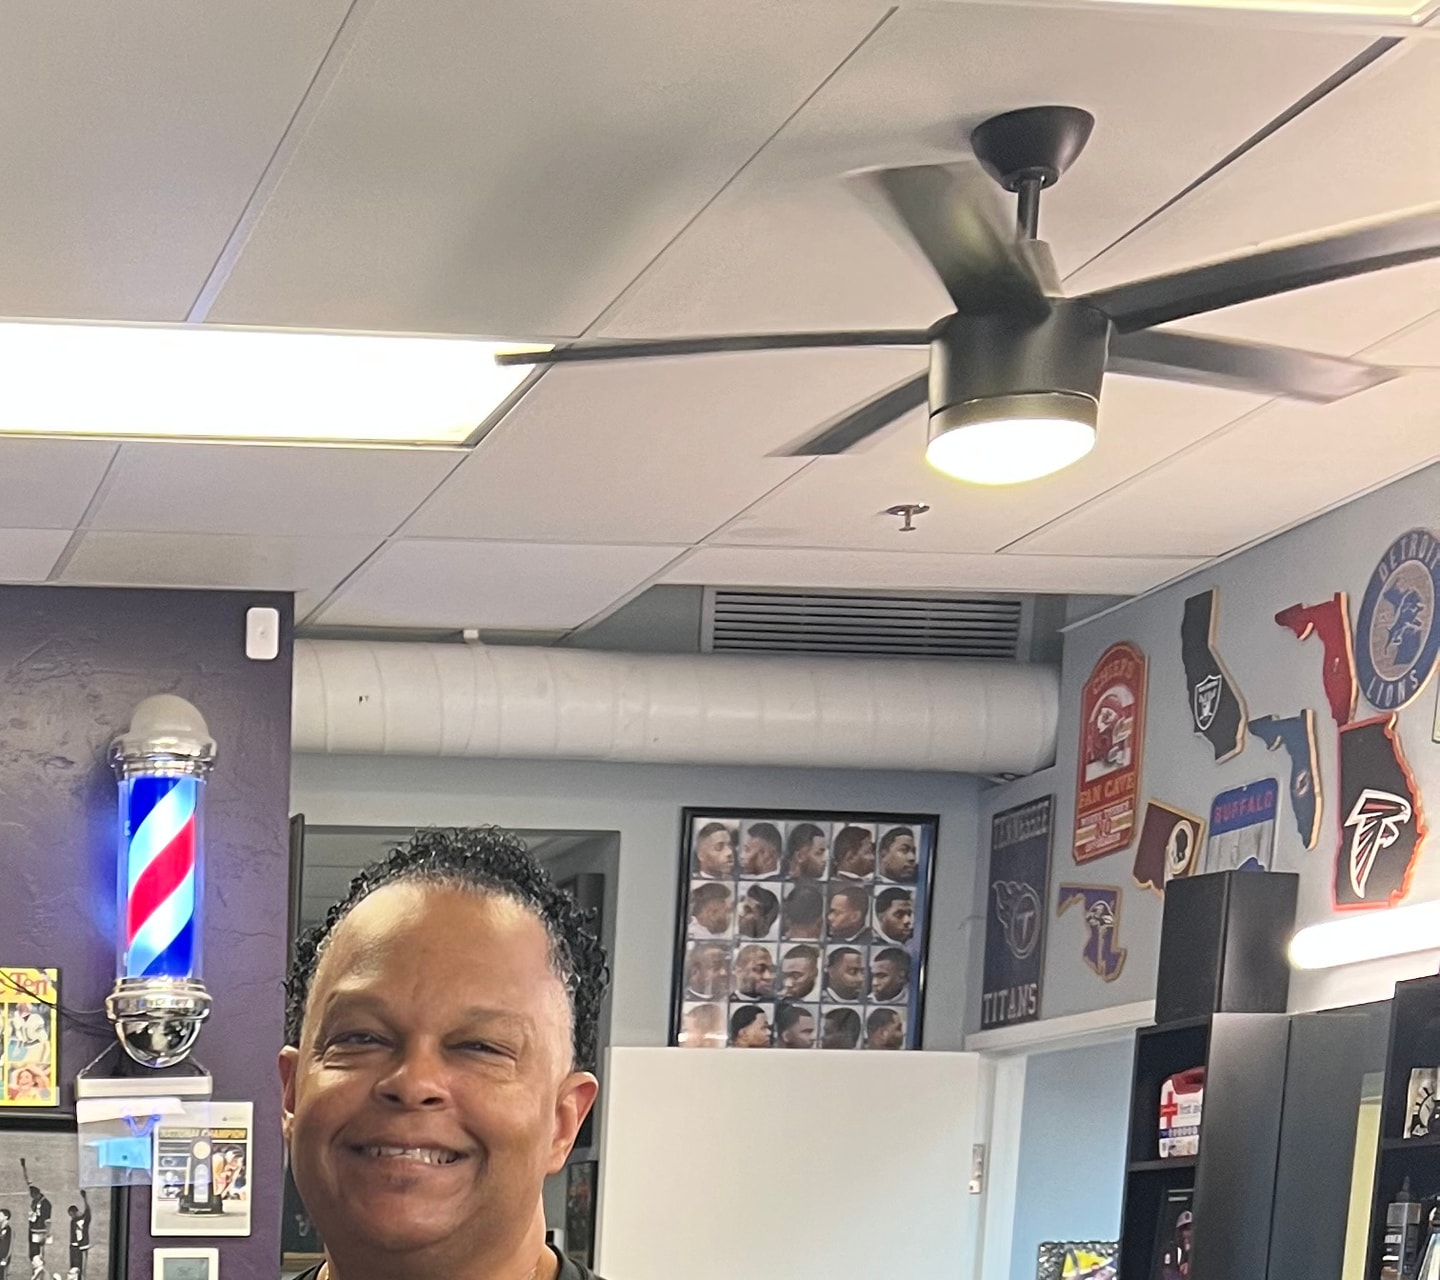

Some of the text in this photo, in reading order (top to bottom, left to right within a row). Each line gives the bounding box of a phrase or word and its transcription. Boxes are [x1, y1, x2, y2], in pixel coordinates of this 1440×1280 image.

[1366, 669, 1419, 707] LIONS
[1080, 773, 1135, 806] FAN CAVE
[1214, 791, 1274, 824] BUFFALO
[9, 973, 50, 997] Ten
[984, 983, 1037, 1024] TITANS
